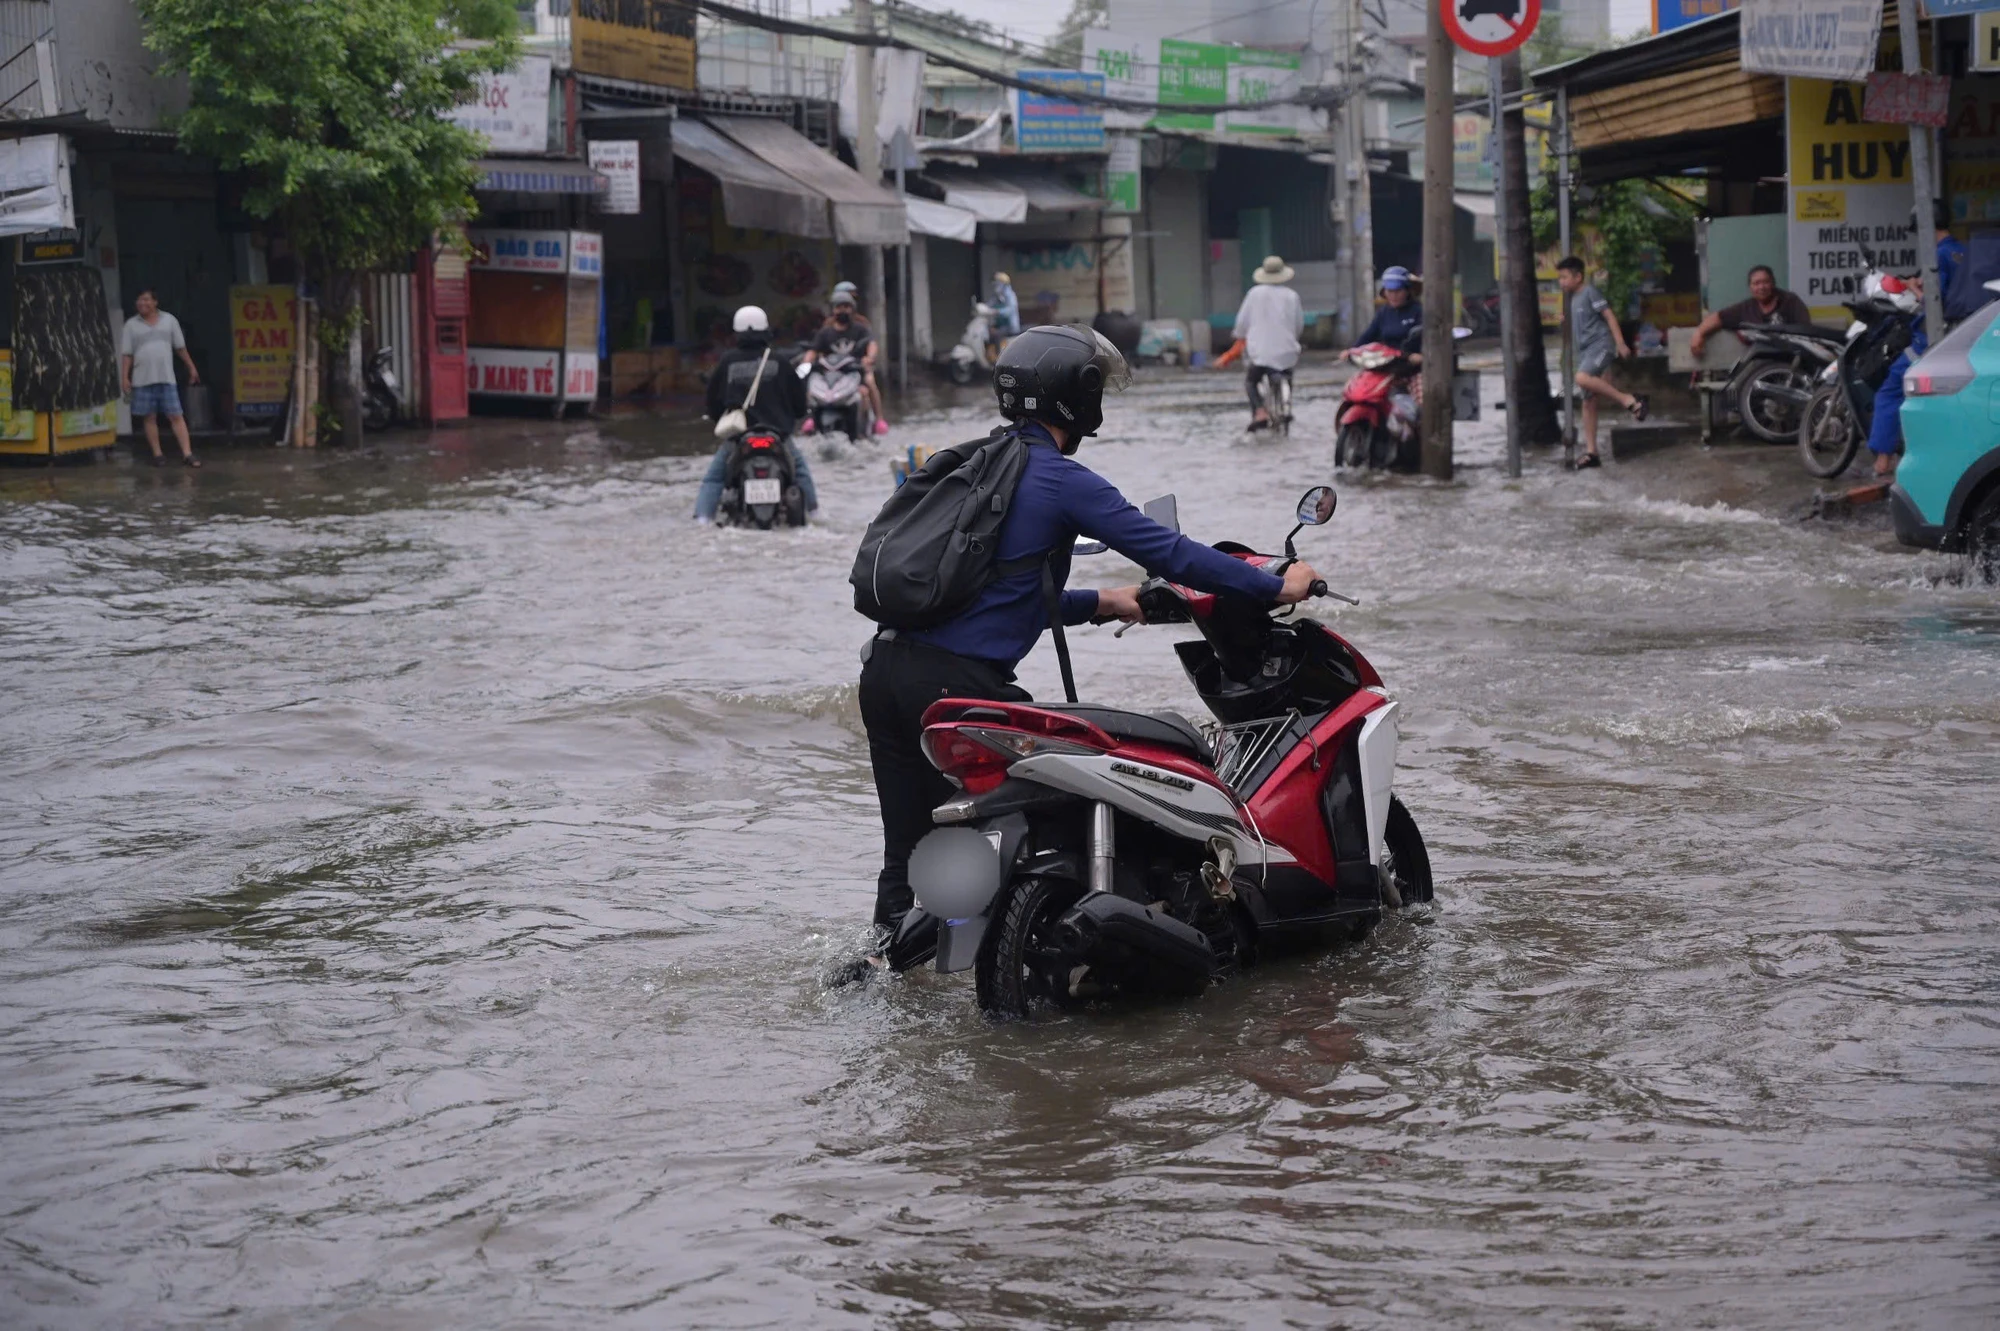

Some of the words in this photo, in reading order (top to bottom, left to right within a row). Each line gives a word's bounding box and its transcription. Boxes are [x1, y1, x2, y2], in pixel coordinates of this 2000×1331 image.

[1813, 140, 1910, 181] HUY
[1819, 221, 1870, 243] MIẾNG
[1875, 222, 1908, 242] DÁN
[534, 240, 562, 258] GIA
[1808, 250, 1859, 270] TIGER
[1866, 248, 1917, 269] BALM
[243, 293, 278, 322] GÀ
[235, 327, 289, 349] TAM
[483, 363, 528, 393] MANG
[1142, 769, 1197, 792] BLADE
